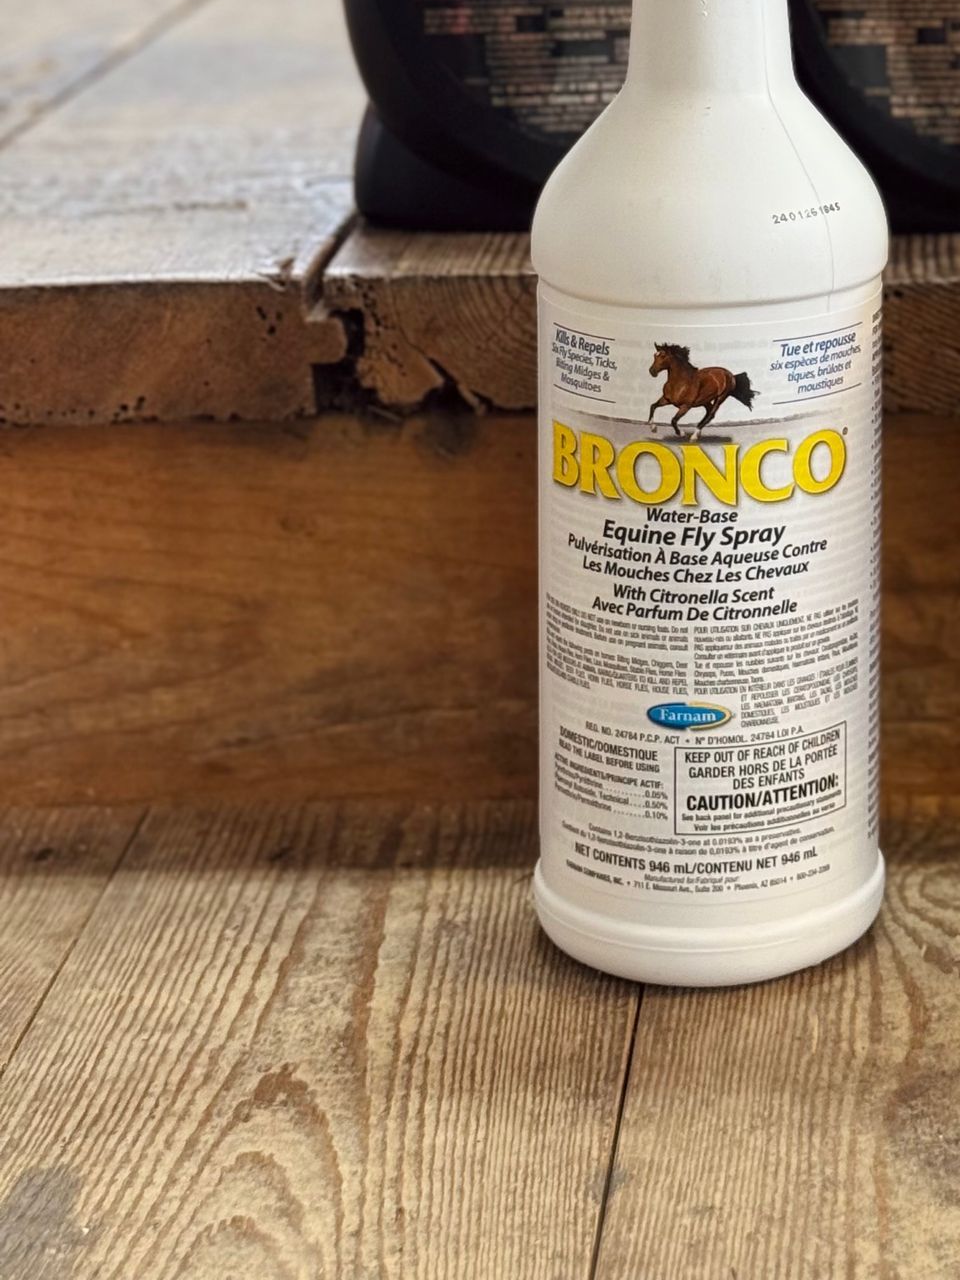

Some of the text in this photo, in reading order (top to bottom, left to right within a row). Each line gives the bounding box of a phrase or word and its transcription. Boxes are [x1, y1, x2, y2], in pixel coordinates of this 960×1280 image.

[555, 328, 610, 356] Kills & Repels
[780, 331, 857, 358] Tue et repousse
[567, 348, 595, 367] Species,
[595, 356, 618, 371] Ticks,
[769, 344, 863, 372] six espèces de mouches
[844, 359, 853, 369] et
[560, 372, 602, 393] Mosquitoes
[573, 363, 602, 381] Midges
[602, 370, 611, 382] &
[797, 375, 845, 394] moustiques
[646, 507, 739, 524] Water-Base
[603, 518, 787, 552] Equine Fly Spray
[568, 532, 828, 569] Pulvérisation À Base Aqueuse Contre
[582, 555, 810, 584] Les Mouches Chez Les Chevaux
[613, 583, 776, 605] With Citronella Scent
[592, 596, 798, 622] Avec Parfum De Citronnelle
[659, 708, 717, 721] Farnam
[559, 725, 659, 761] DOMESTIC/DOMESTIQUE
[614, 728, 638, 741] 24784
[639, 733, 662, 743] P.C.P.
[664, 734, 680, 745] ACT
[707, 735, 748, 745] D'HOMOL.
[750, 731, 775, 743] 24784
[776, 729, 790, 739] LOI
[685, 729, 841, 763] KEEP OUT OF REACH OF CHILDREN
[584, 748, 604, 764] LABEL
[605, 754, 634, 770] BEFORE
[635, 761, 661, 773] USING
[688, 744, 839, 779] GARDER HORS DE LA PORTÉE
[639, 780, 664, 790] ACTIF:
[732, 768, 806, 790] DES ENFANTS
[686, 773, 839, 811] CAUTION/ATTENTION:
[733, 811, 743, 820] for
[575, 841, 819, 875] NET CONTENTS 946 mL/CONTENU NET 946 mL
